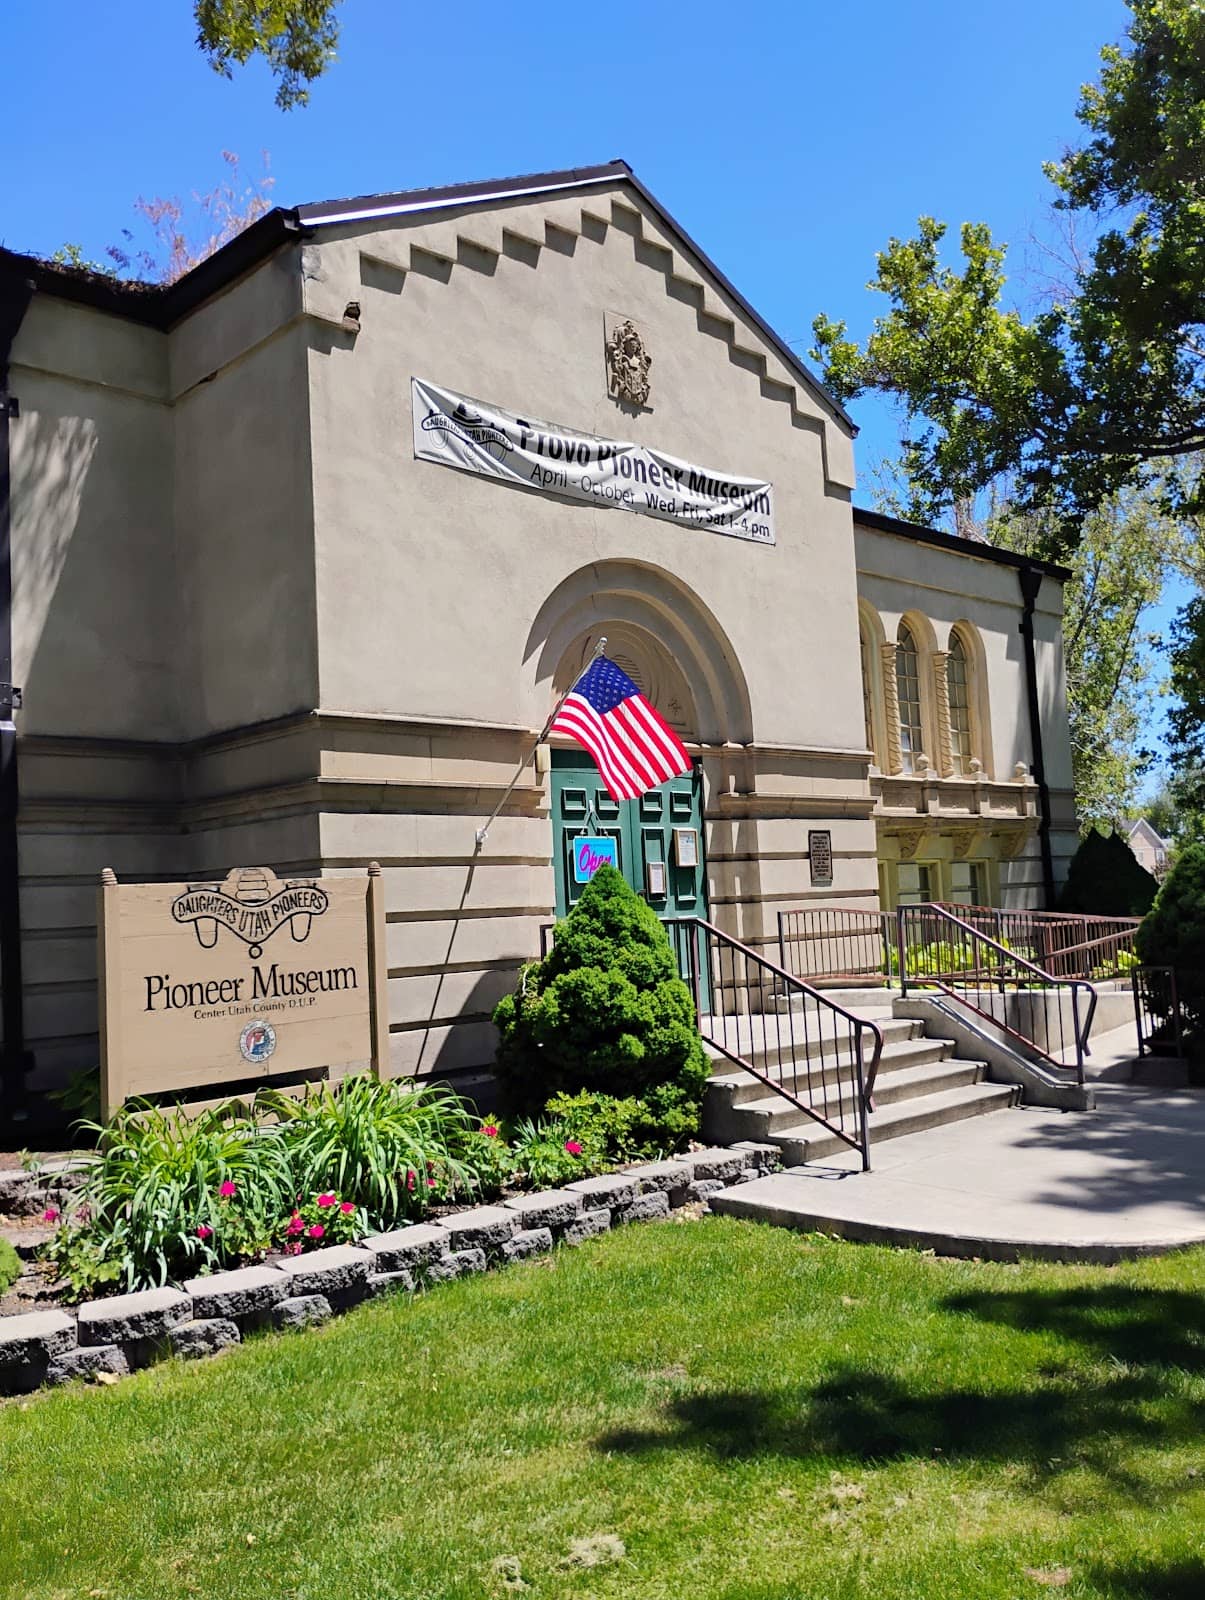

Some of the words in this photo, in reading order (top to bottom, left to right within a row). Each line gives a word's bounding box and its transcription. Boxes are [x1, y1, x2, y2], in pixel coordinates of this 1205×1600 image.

[517, 419, 590, 467] Provo
[598, 445, 683, 492] Pioneer
[688, 467, 770, 515] Museum
[530, 463, 567, 488] April
[581, 475, 636, 504] October
[645, 492, 678, 517] Wed,
[682, 501, 703, 523] Fri,
[706, 508, 726, 526] Sat
[752, 522, 770, 537] pm
[178, 895, 240, 924] DAUGHTERS
[238, 909, 272, 938] UTAH
[272, 891, 324, 920] PIONEERS
[143, 974, 245, 1012] Pioneer
[251, 963, 358, 1000] Museum
[193, 1008, 226, 1020] Center
[228, 1004, 252, 1016] Utah
[253, 1001, 287, 1013] County
